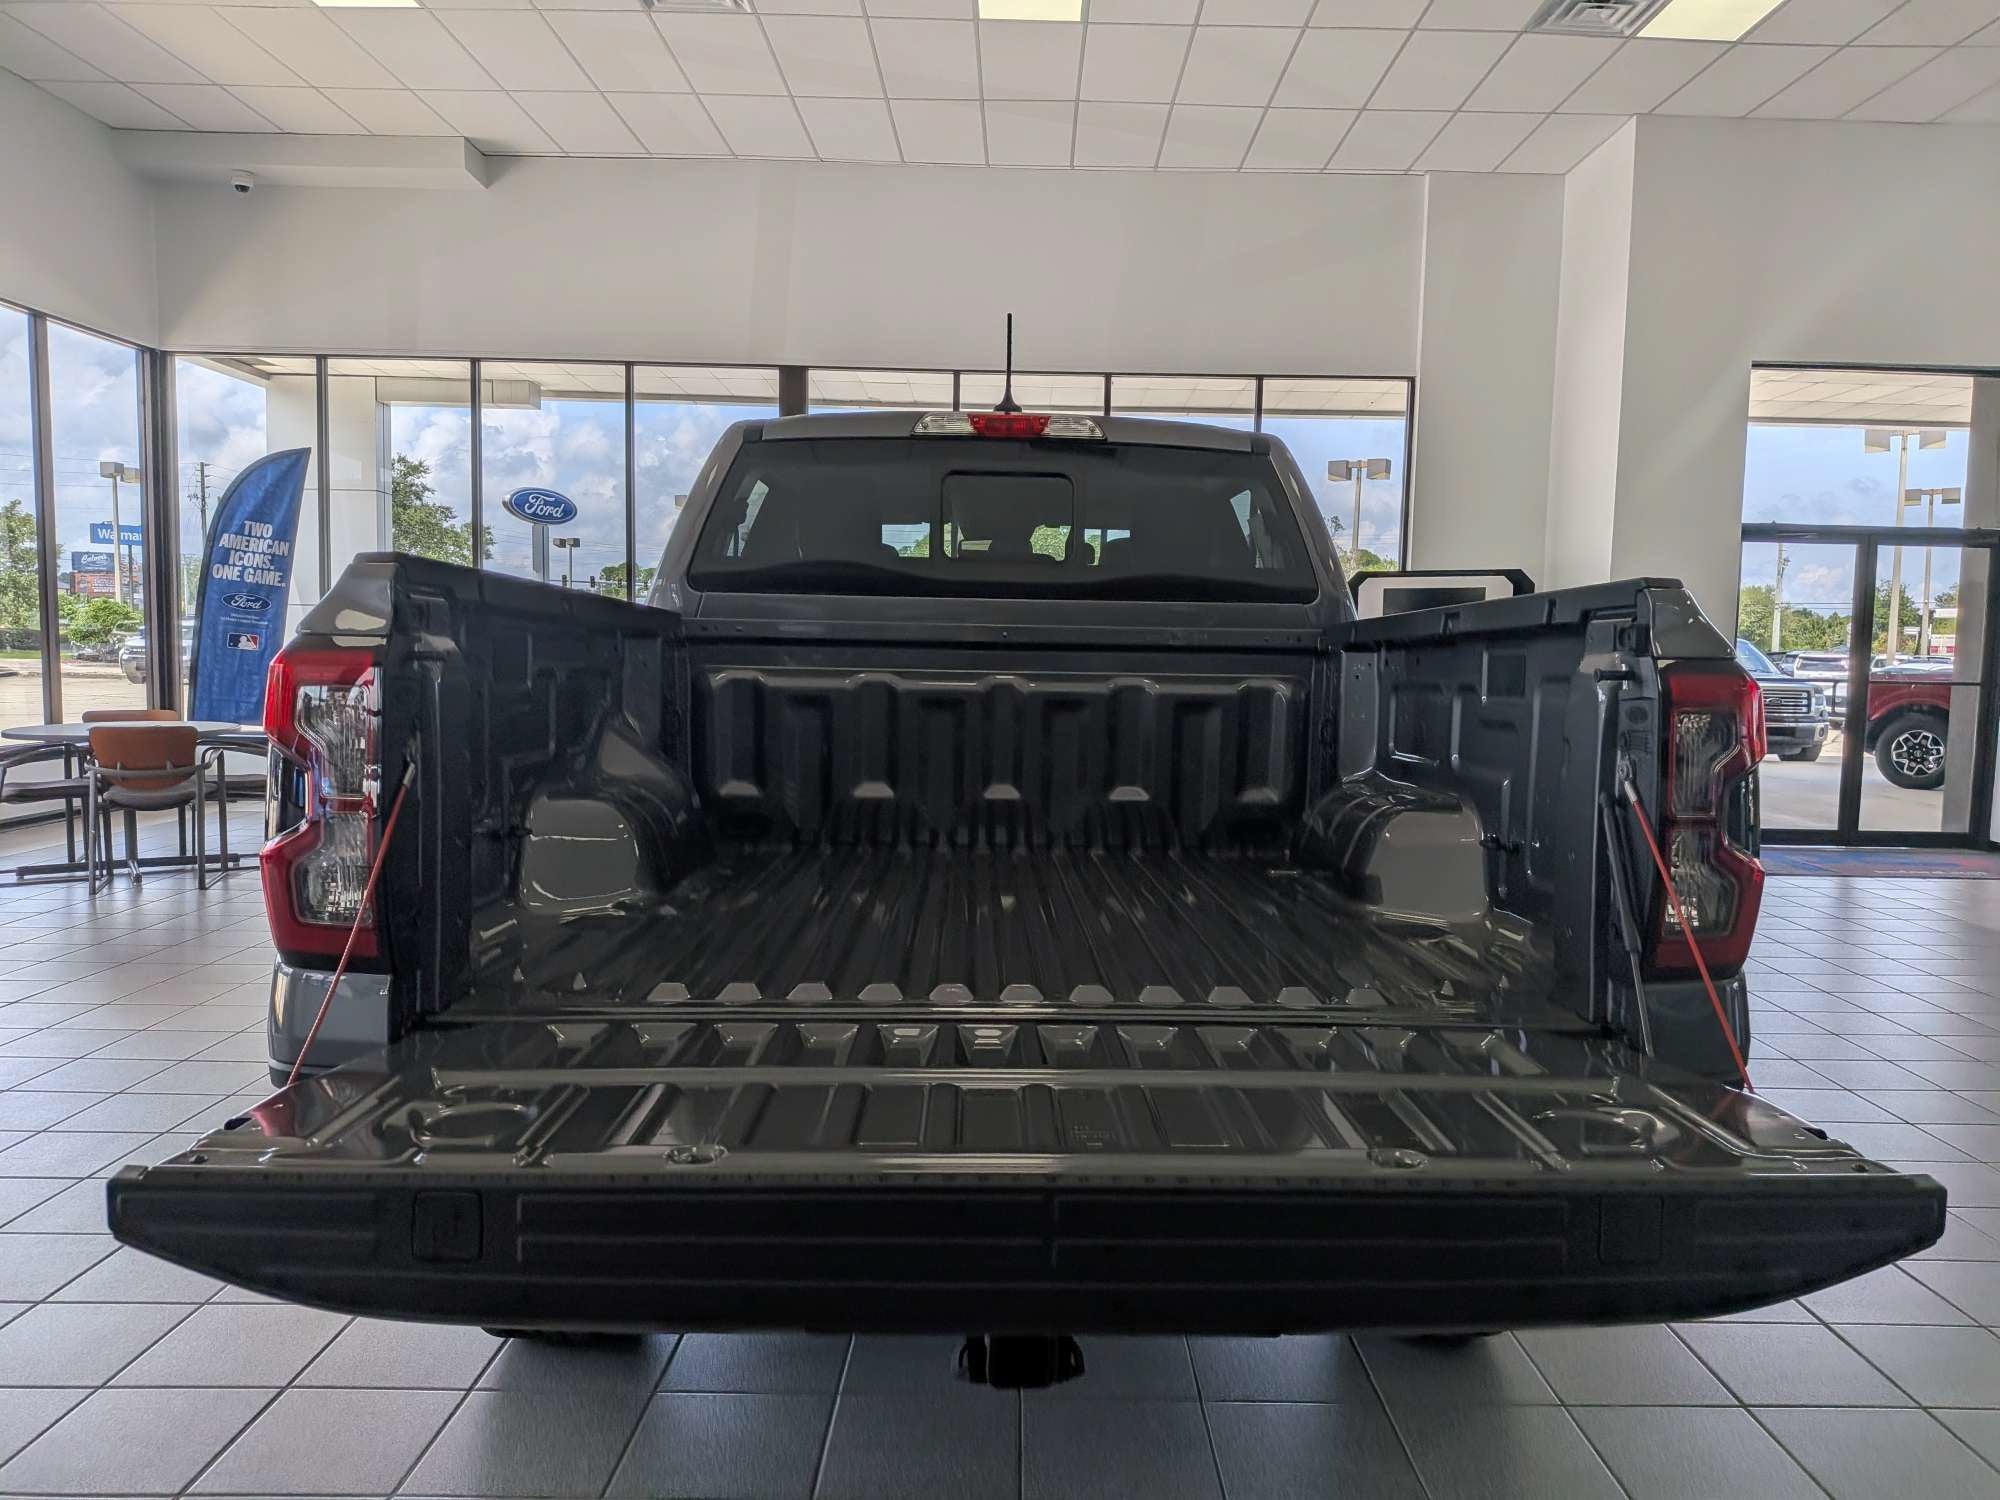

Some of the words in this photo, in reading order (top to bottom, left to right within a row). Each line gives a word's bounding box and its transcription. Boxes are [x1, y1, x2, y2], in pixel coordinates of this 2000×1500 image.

[525, 494, 565, 517] Ford
[243, 520, 273, 538] TWO
[218, 533, 290, 557] AMERICAN
[228, 550, 275, 570] ICONS.
[212, 563, 242, 581] ONE
[243, 567, 287, 587] GAME.
[231, 594, 262, 609] Ford
